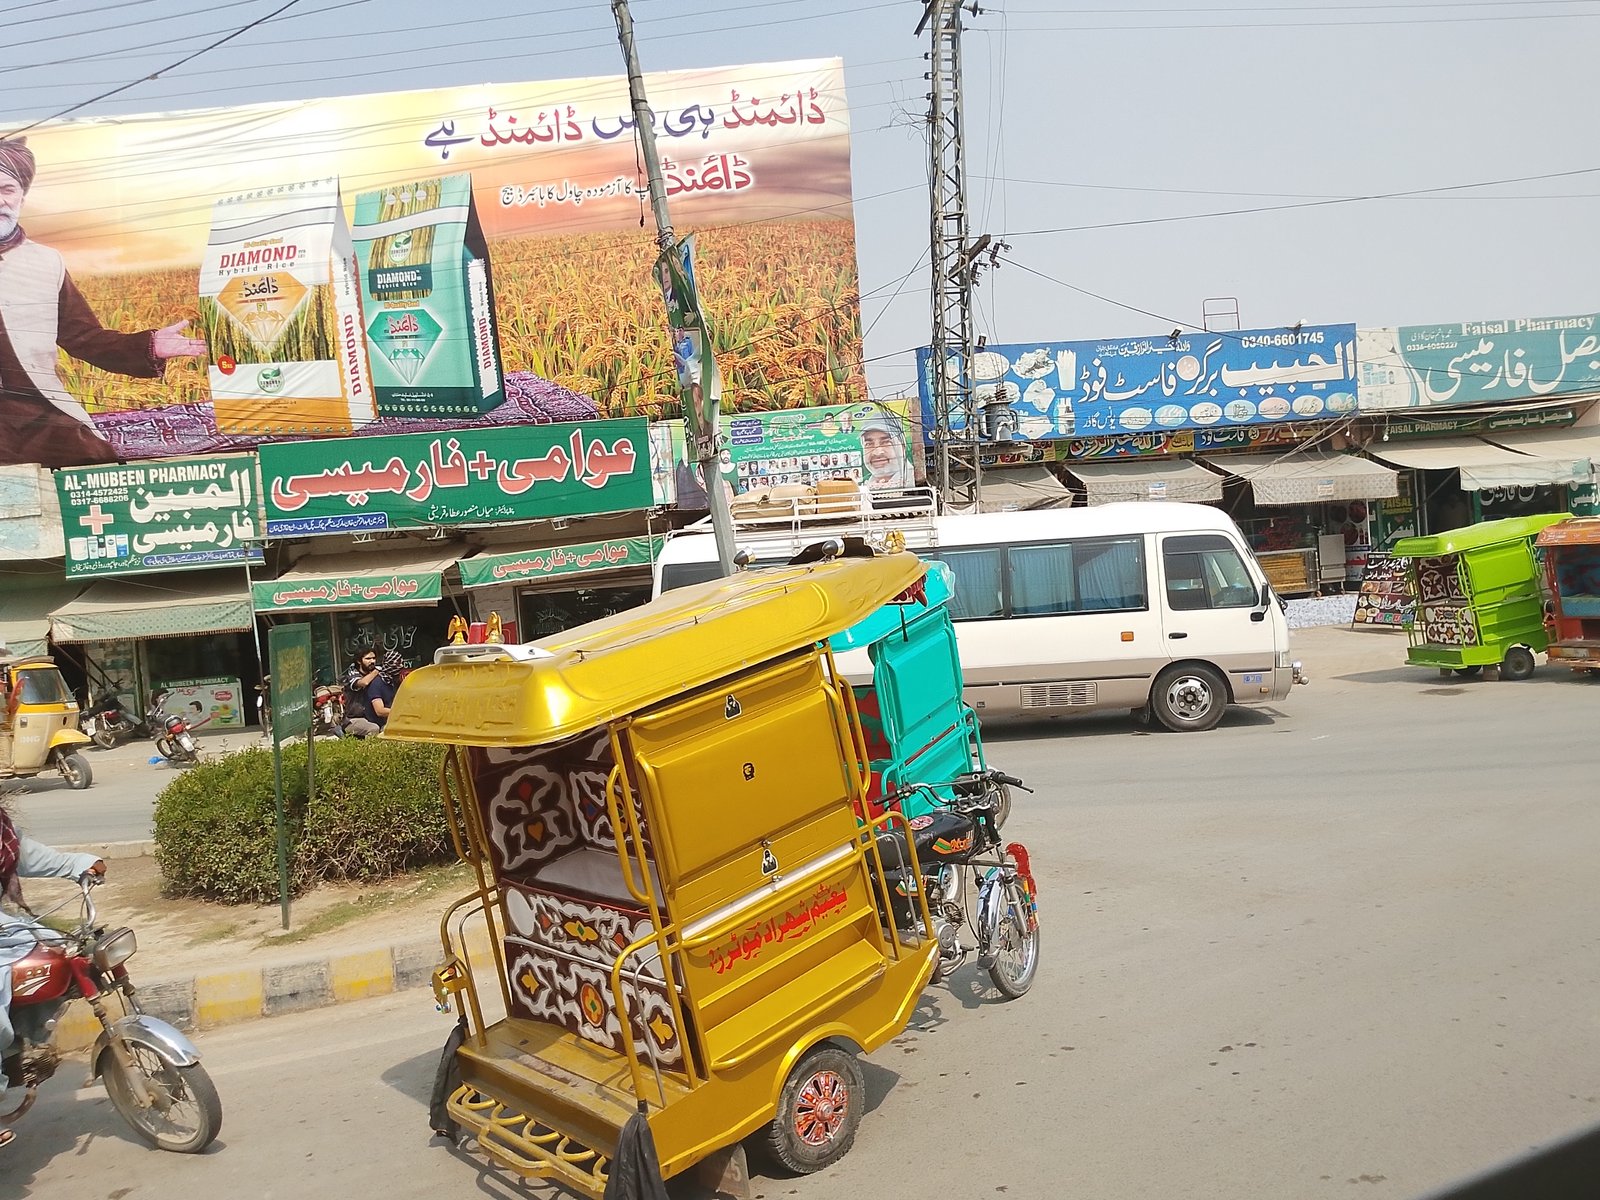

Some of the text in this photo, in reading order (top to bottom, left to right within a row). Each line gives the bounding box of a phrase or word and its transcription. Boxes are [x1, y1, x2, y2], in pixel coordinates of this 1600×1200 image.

[424, 117, 475, 160] ہے
[664, 104, 715, 139] ہی
[556, 181, 583, 203] چاول
[219, 245, 297, 269] DIAMOND
[219, 261, 295, 276] Hybrid Rice
[377, 270, 417, 284] DIAMOND
[478, 317, 492, 370] DIAMOND
[1241, 332, 1324, 349] 0340-6601745
[1461, 316, 1596, 337] Faisal Pharmacy
[344, 314, 362, 396] DIAMOND
[1220, 340, 1355, 396] الحبیب
[1425, 337, 1528, 401] فارمیسی
[1078, 357, 1107, 403] فوڈ
[1103, 361, 1177, 401] فاسٹ
[1386, 424, 1413, 435] FAISAL
[1415, 421, 1458, 432] PHARMACY
[64, 463, 227, 491] AL-MUBEEN PHARMACY
[270, 428, 637, 512] عوامی فارمیسی
[130, 468, 252, 523] المبین
[1382, 497, 1413, 508] FAISAL
[133, 509, 255, 554] فارمیسی
[493, 541, 629, 578] عوامی فارمیسی
[273, 576, 419, 604] عوامی فارمیسی
